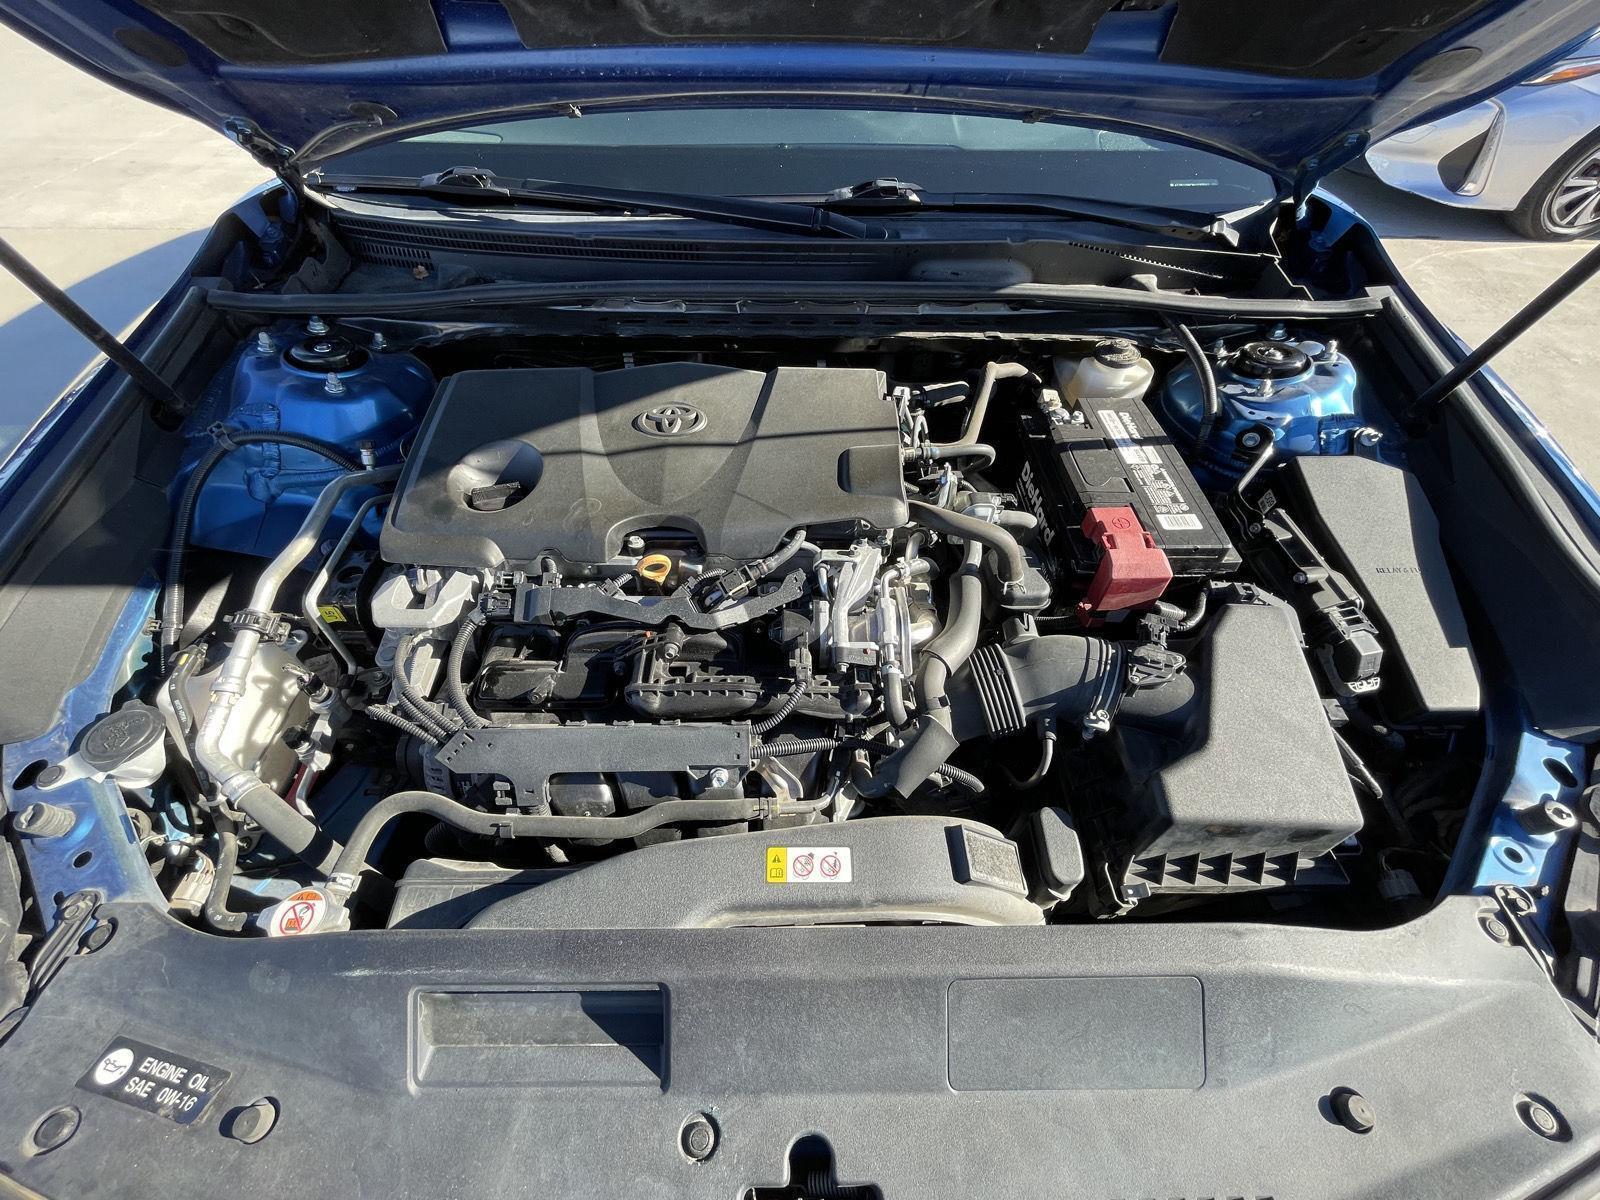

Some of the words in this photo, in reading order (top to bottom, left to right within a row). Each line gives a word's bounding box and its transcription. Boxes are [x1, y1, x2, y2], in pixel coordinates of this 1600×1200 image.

[1021, 460, 1055, 546] DieHard
[138, 1057, 188, 1083] ENGINE
[188, 1073, 210, 1092] OIL
[124, 1077, 155, 1098] SAE
[156, 1087, 198, 1111] 0W-16
